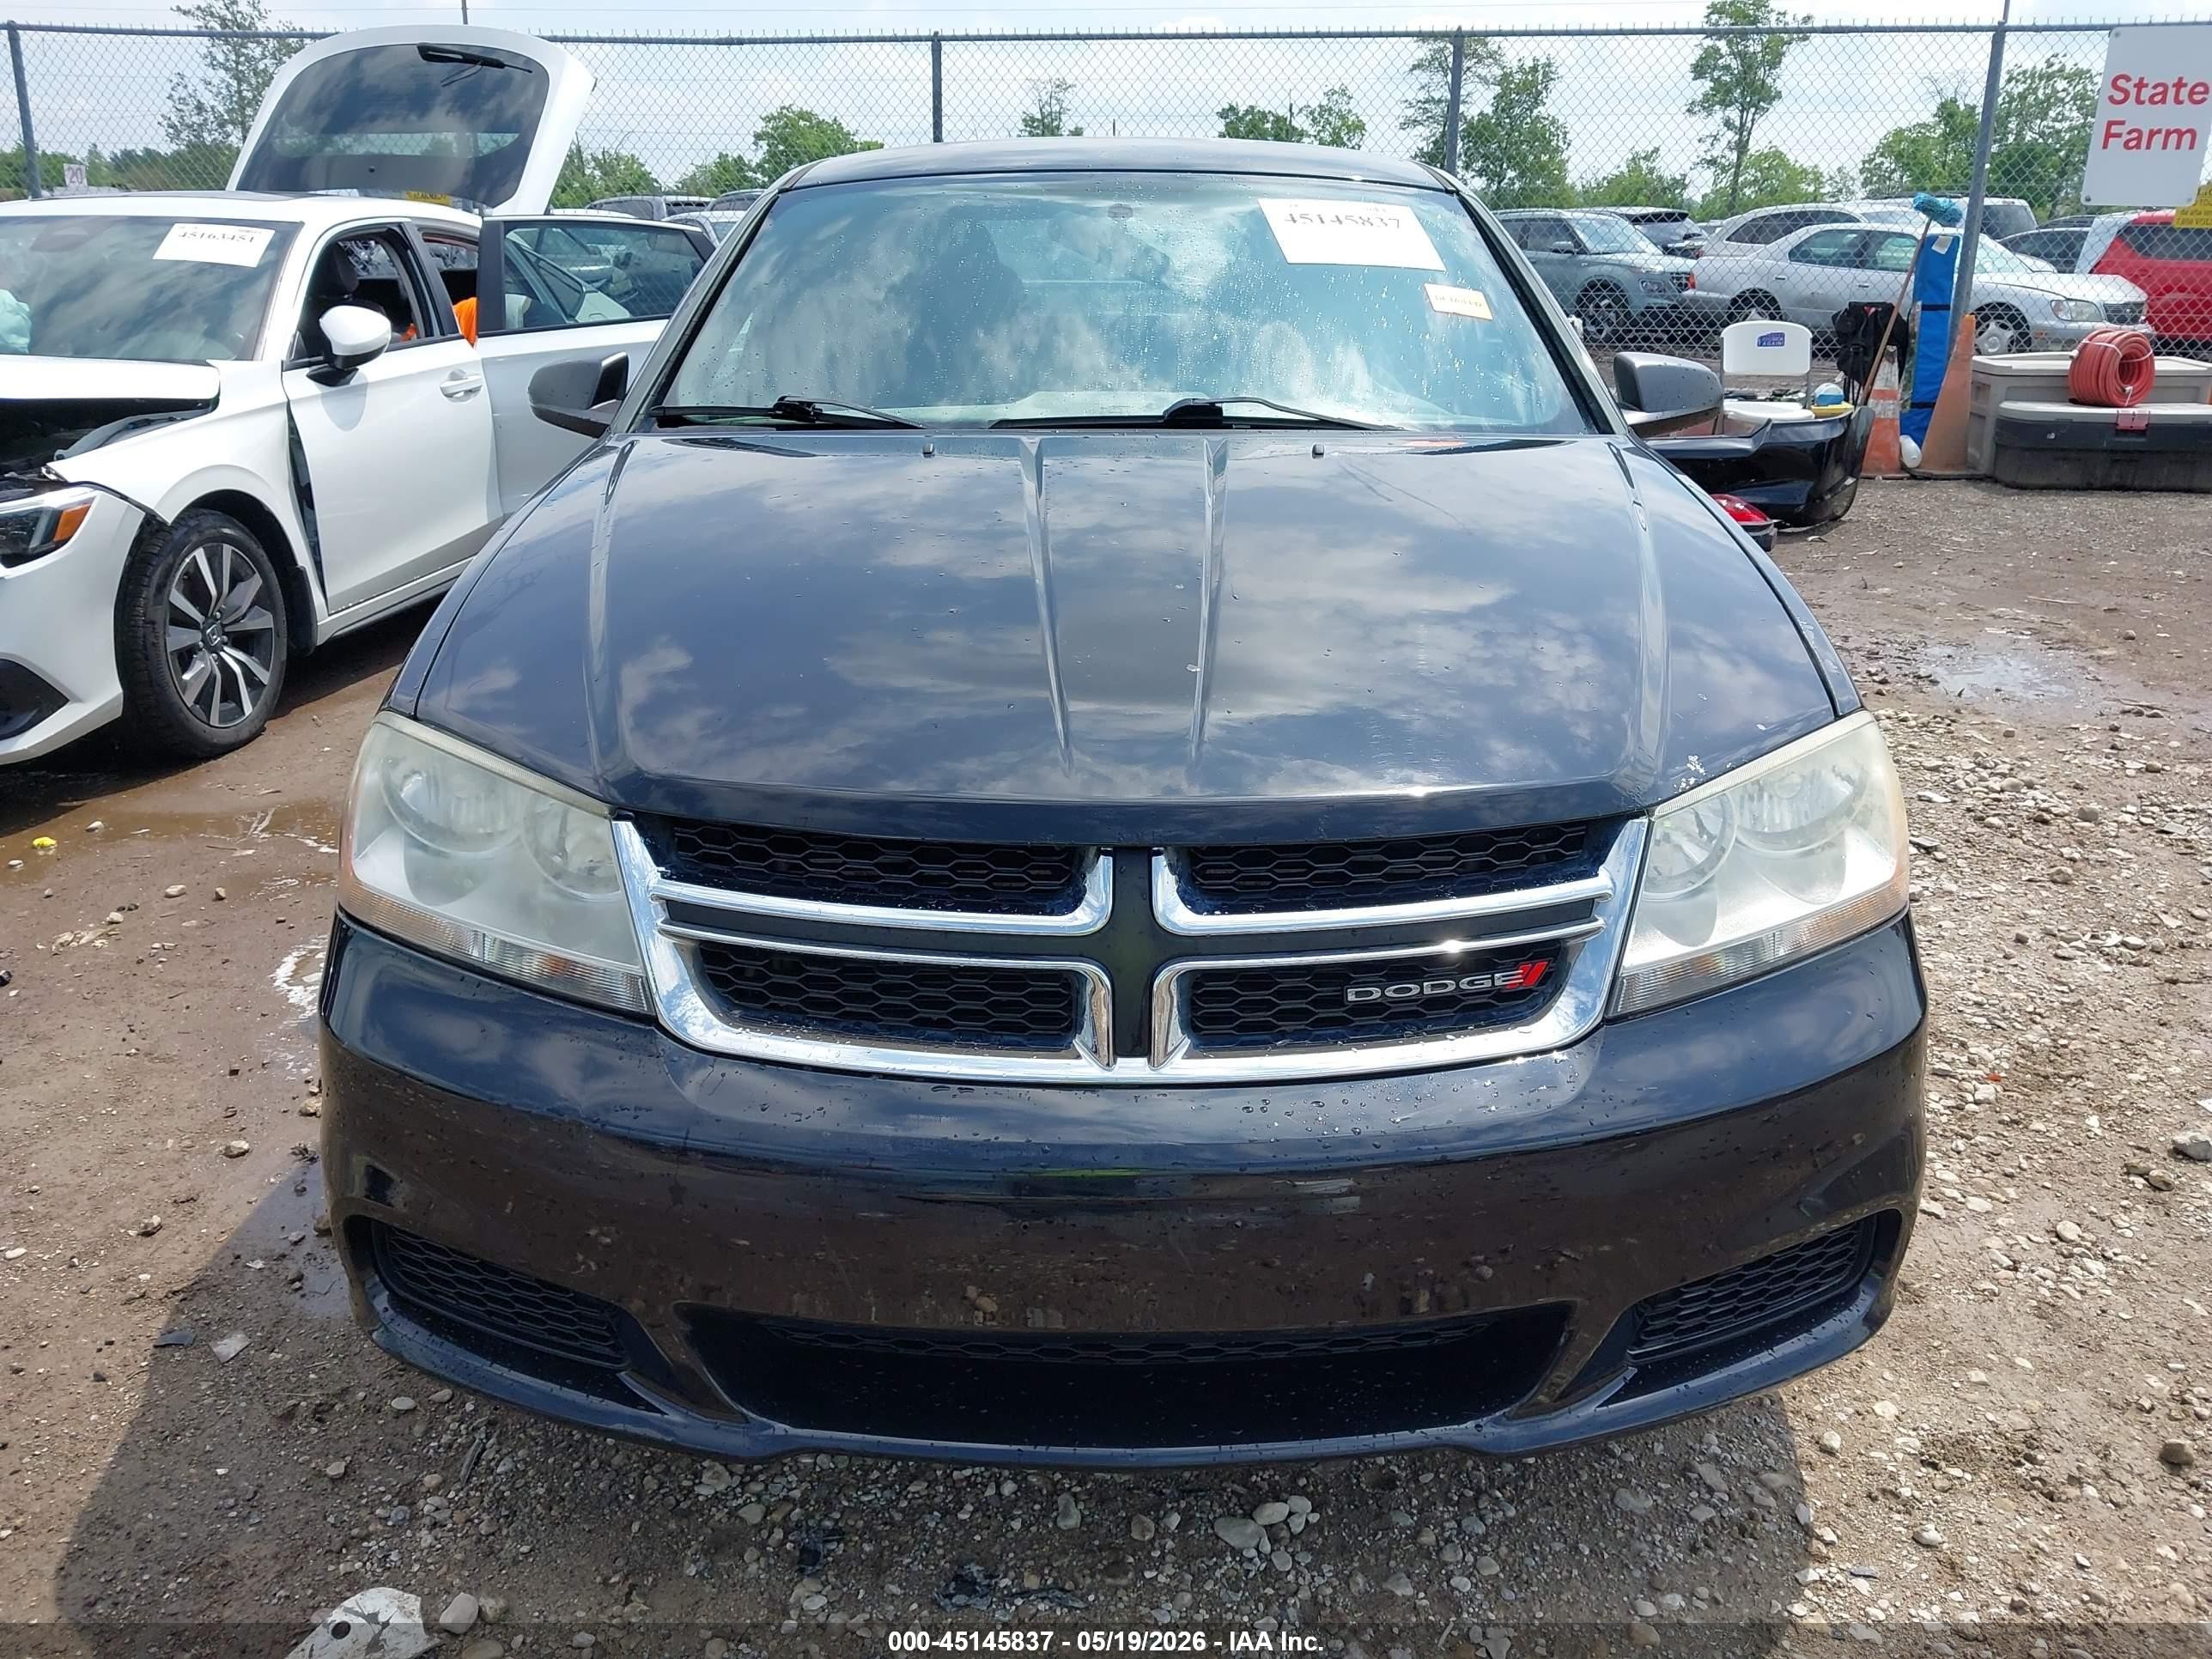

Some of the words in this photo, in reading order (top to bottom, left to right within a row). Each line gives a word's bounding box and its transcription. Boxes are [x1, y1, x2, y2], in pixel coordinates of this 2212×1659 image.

[2107, 73, 2210, 106] State
[2101, 119, 2198, 151] Farm
[67, 167, 83, 185] 20
[1285, 213, 1401, 229] 45145837
[1346, 969, 1524, 1002] DODGE
